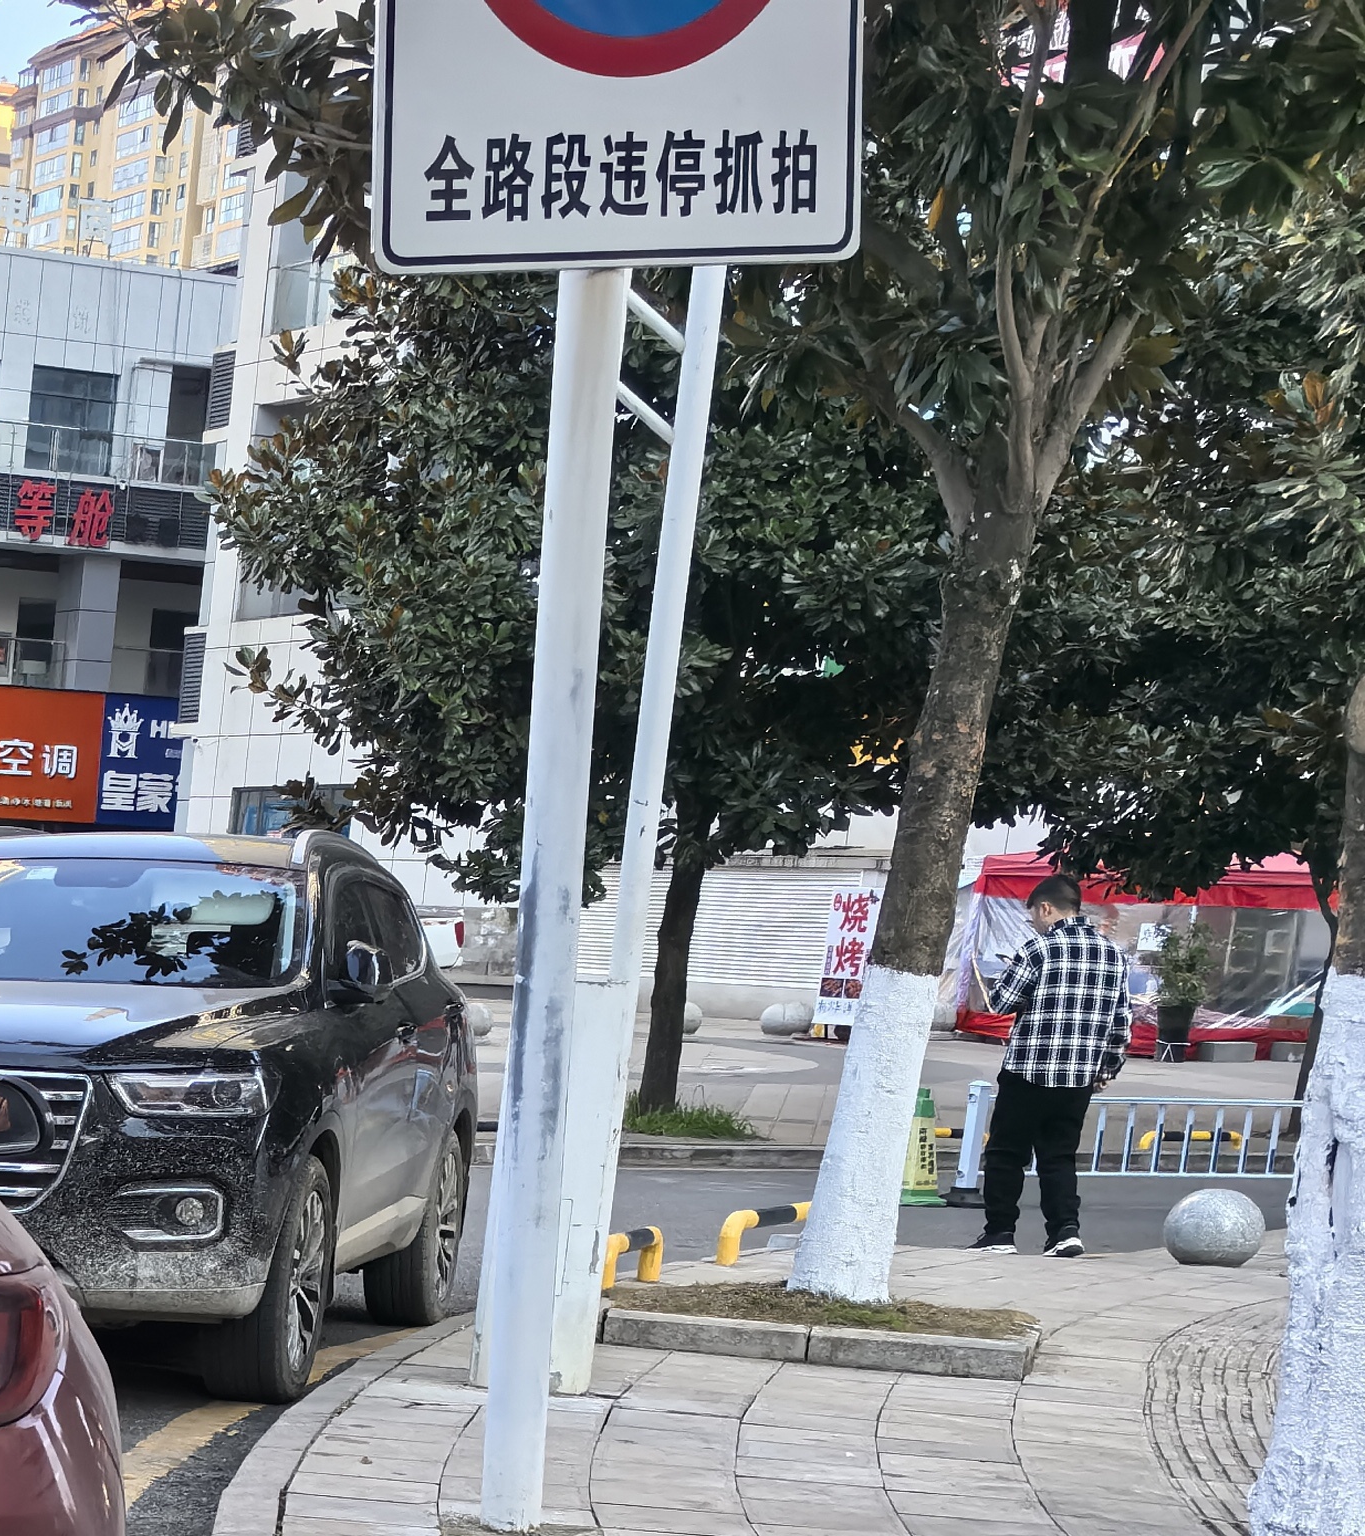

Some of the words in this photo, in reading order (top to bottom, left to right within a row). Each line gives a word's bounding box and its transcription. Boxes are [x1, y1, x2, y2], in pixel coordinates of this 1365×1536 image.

[424, 128, 818, 222] 全路段违停抓拍
[100, 770, 179, 813] 皇蒙
[833, 892, 870, 978] 烧烤
